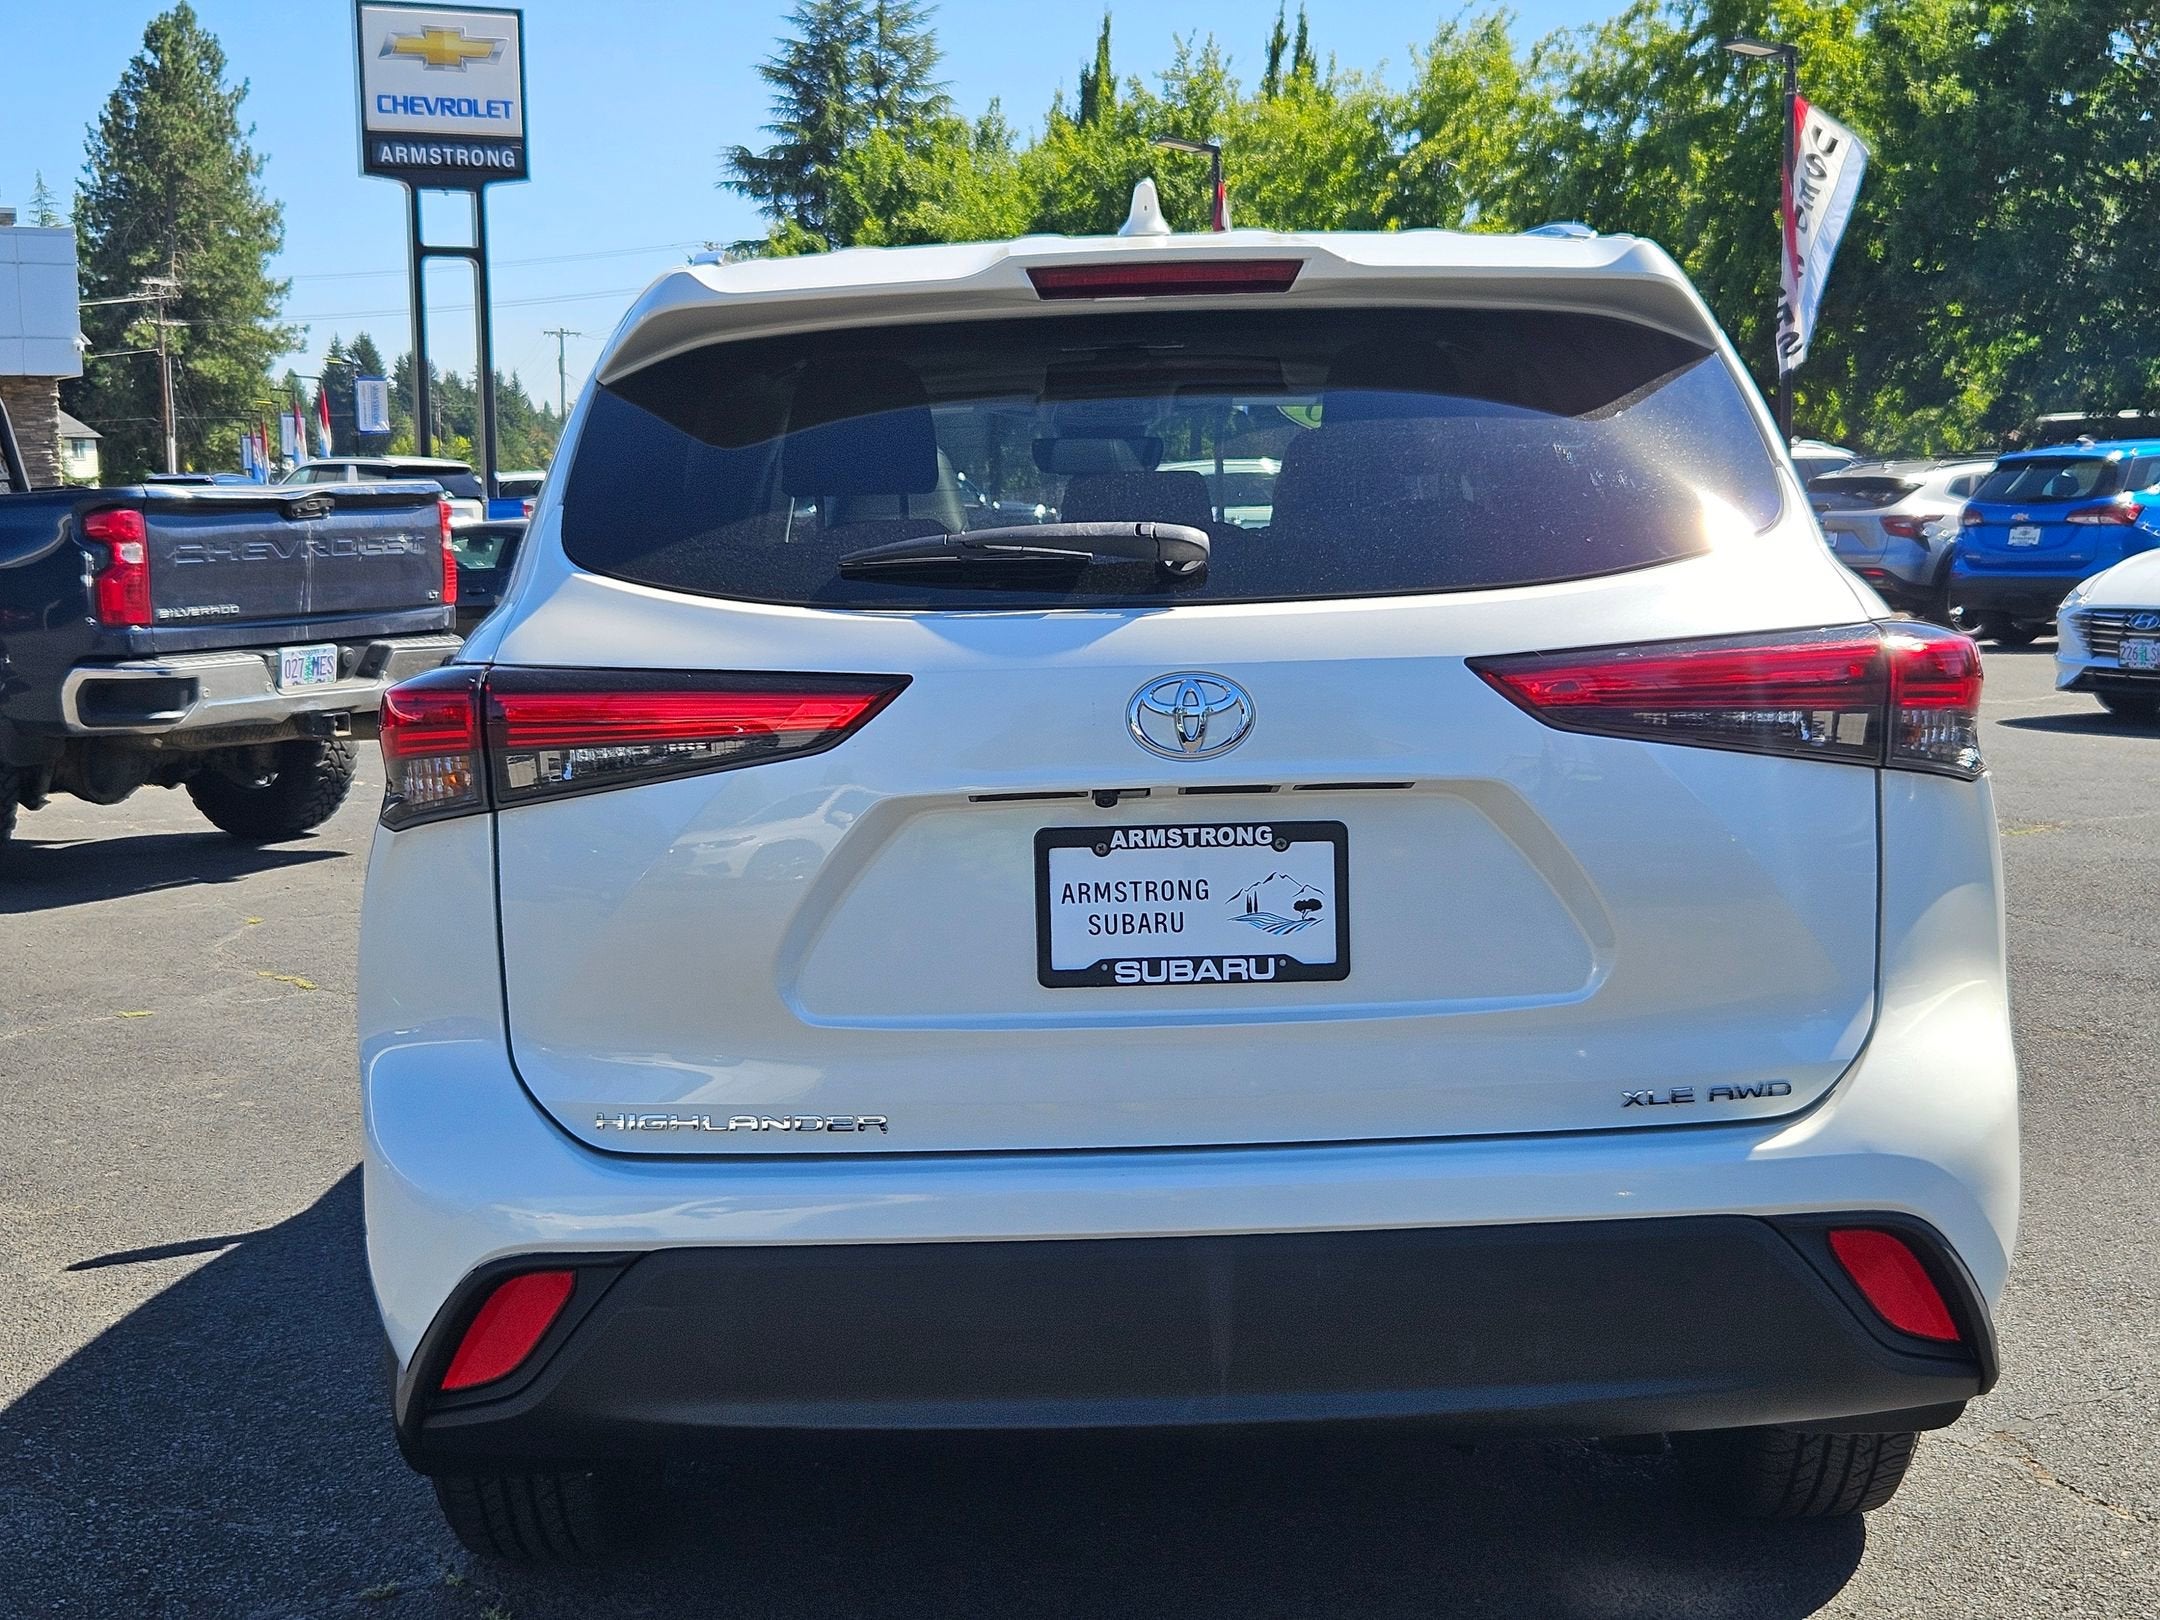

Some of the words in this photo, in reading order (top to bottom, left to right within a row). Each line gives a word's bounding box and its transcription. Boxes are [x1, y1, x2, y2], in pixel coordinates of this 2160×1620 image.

[376, 94, 513, 119] CHEVROLET
[380, 145, 516, 168] ARMSTRONG
[1795, 125, 1839, 233] USED
[175, 535, 426, 564] CHEVROLET
[428, 591, 440, 601] LT
[158, 604, 240, 619] SILVERADO
[2120, 645, 2138, 661] 226
[2144, 646, 2160, 662] LS
[285, 658, 305, 679] 027
[1110, 826, 1273, 849] ARMSTRONG
[1060, 878, 1210, 905] ARMSTRONG
[1087, 910, 1185, 936] SUBARU
[1114, 957, 1275, 983] SUBARU
[1621, 1087, 1695, 1108] XLE
[1707, 1079, 1792, 1102] AWD
[595, 1112, 889, 1135] HIGHLANDER
